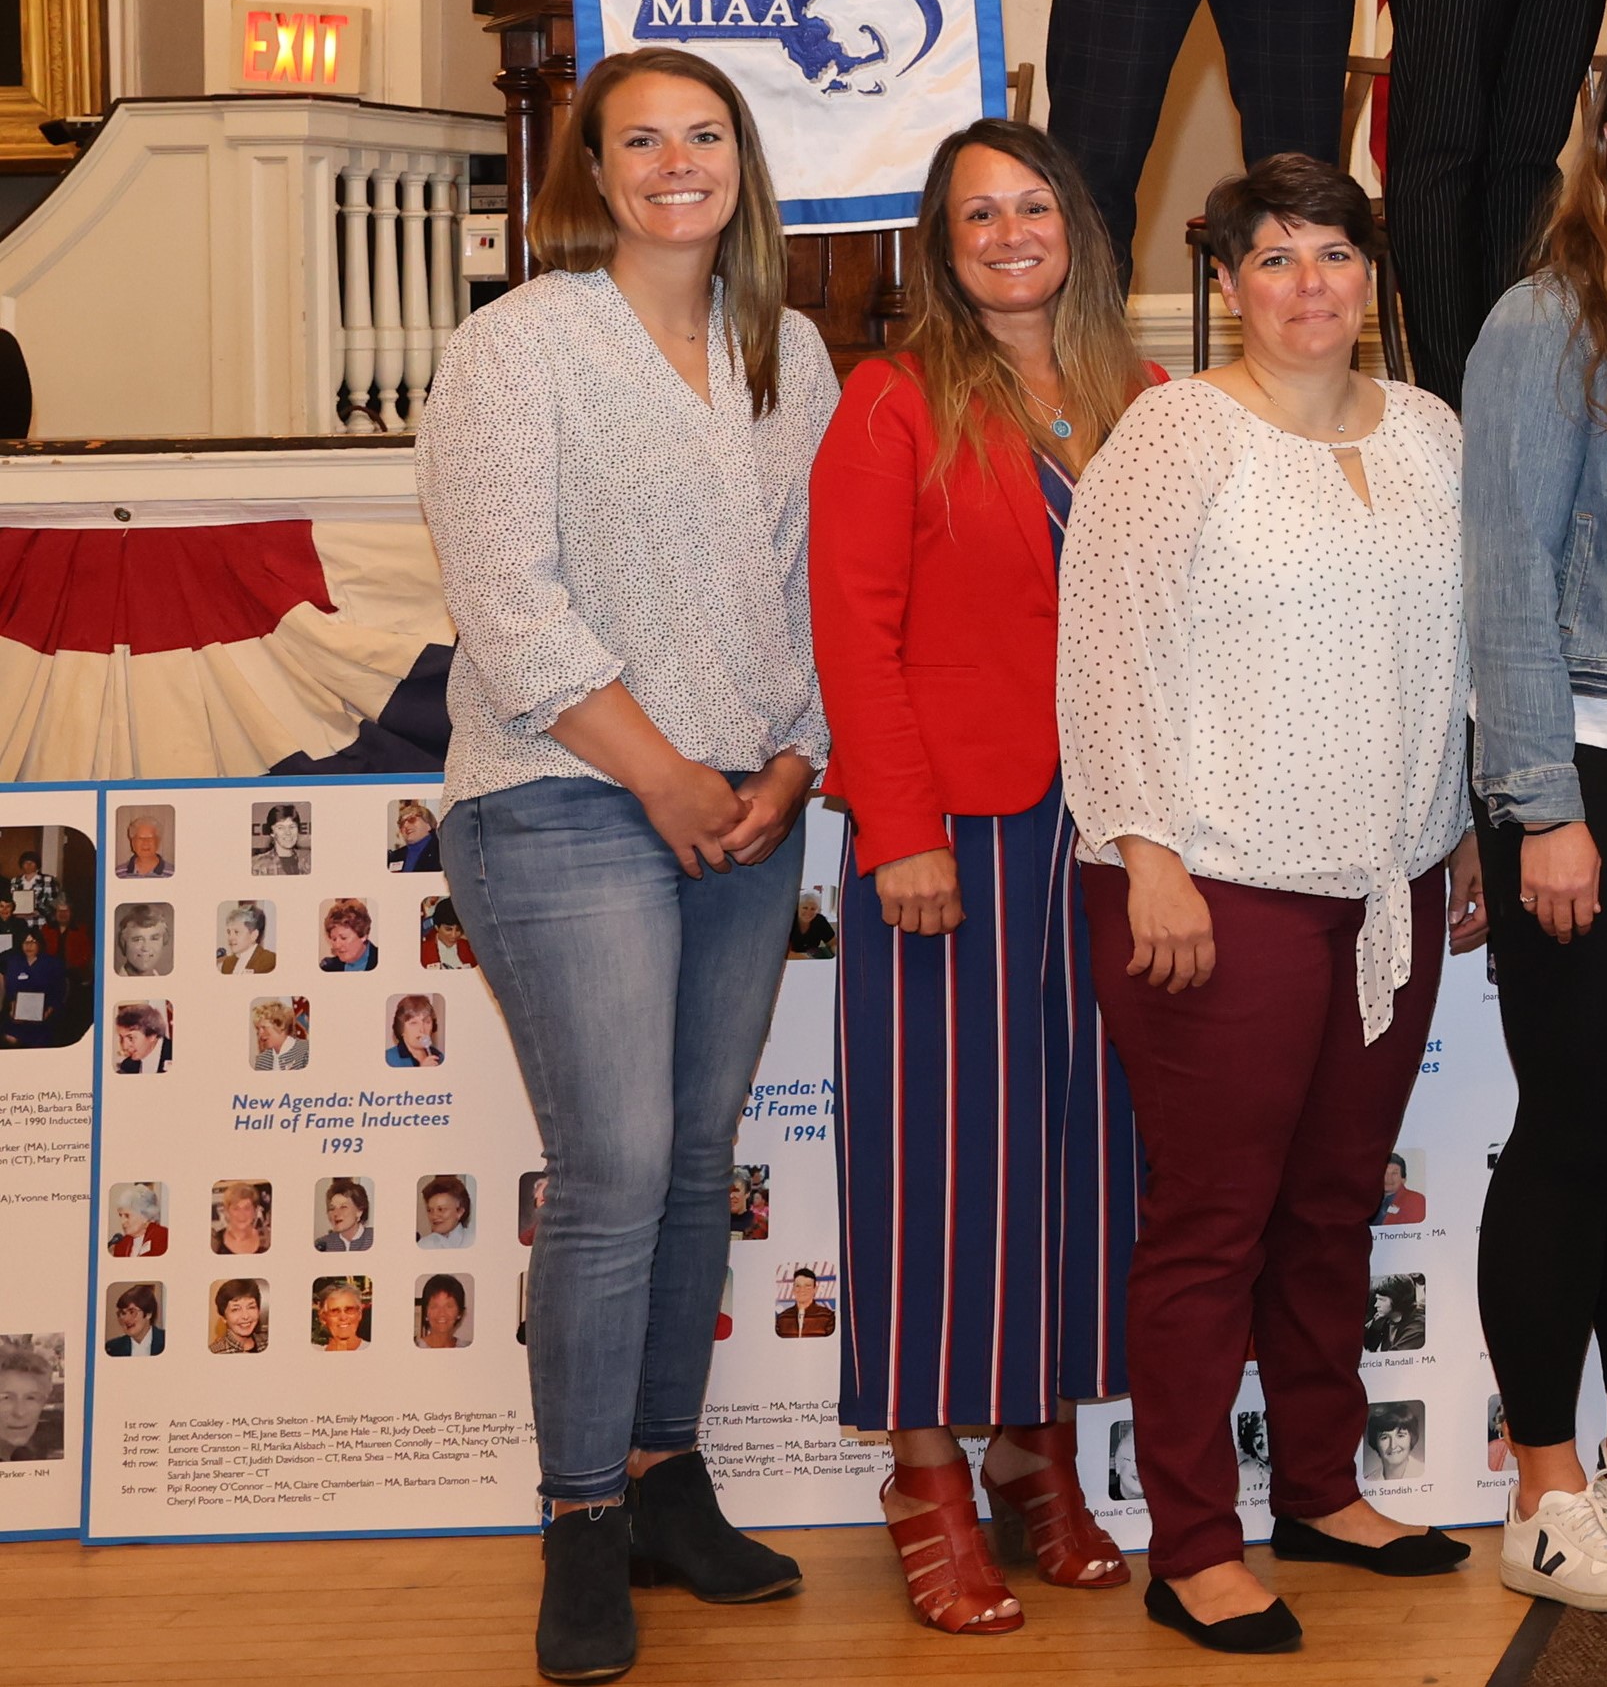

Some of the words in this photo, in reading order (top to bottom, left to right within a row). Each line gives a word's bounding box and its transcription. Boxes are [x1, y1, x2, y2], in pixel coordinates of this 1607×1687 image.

[244, 11, 348, 84] EXIT
[747, 1079, 816, 1101] genda:
[11, 1093, 34, 1101] Fazio
[232, 1094, 275, 1110] New
[279, 1093, 354, 1113] Agenda:
[358, 1091, 453, 1107] Northeast
[38, 1105, 72, 1113] Barbara
[742, 1101, 764, 1121] of
[768, 1101, 817, 1116] Fame
[25, 1117, 46, 1125] 1990
[49, 1116, 92, 1125] Inductee)
[234, 1114, 274, 1130] Hall
[280, 1114, 300, 1133] of
[305, 1113, 354, 1129] Fame
[361, 1111, 450, 1128] Inductees
[785, 1125, 826, 1142] 1994
[51, 1142, 90, 1150] Lorraine
[322, 1137, 364, 1154] 1993
[37, 1155, 60, 1165] Mary
[64, 1154, 86, 1162] Pratt
[1380, 1230, 1421, 1242] Thornburg
[1385, 1357, 1414, 1366] Randall
[1421, 1355, 1436, 1364] MA
[169, 1419, 187, 1429] Ann
[189, 1418, 224, 1429] Coakley
[251, 1416, 275, 1426] Chris
[277, 1415, 308, 1425] Shelton
[336, 1414, 357, 1425] Emily
[360, 1414, 394, 1425] Magoon
[424, 1412, 452, 1423] Gladys
[454, 1411, 497, 1422] Brightman
[718, 1456, 743, 1465] Diane
[745, 1455, 775, 1466] Wright
[805, 1453, 837, 1462] Barbara
[840, 1452, 871, 1461] Stevens
[34, 1469, 50, 1477] NH
[255, 1468, 270, 1477] CT
[731, 1468, 760, 1477] Sandra
[813, 1465, 843, 1475] Denise
[845, 1464, 875, 1476] Legault
[1379, 1487, 1412, 1496] Standish
[1420, 1483, 1434, 1492] CT
[1477, 1479, 1506, 1488] Patricia
[167, 1497, 195, 1508] Cheryl
[198, 1496, 224, 1505] Poore
[253, 1494, 275, 1503] Dora
